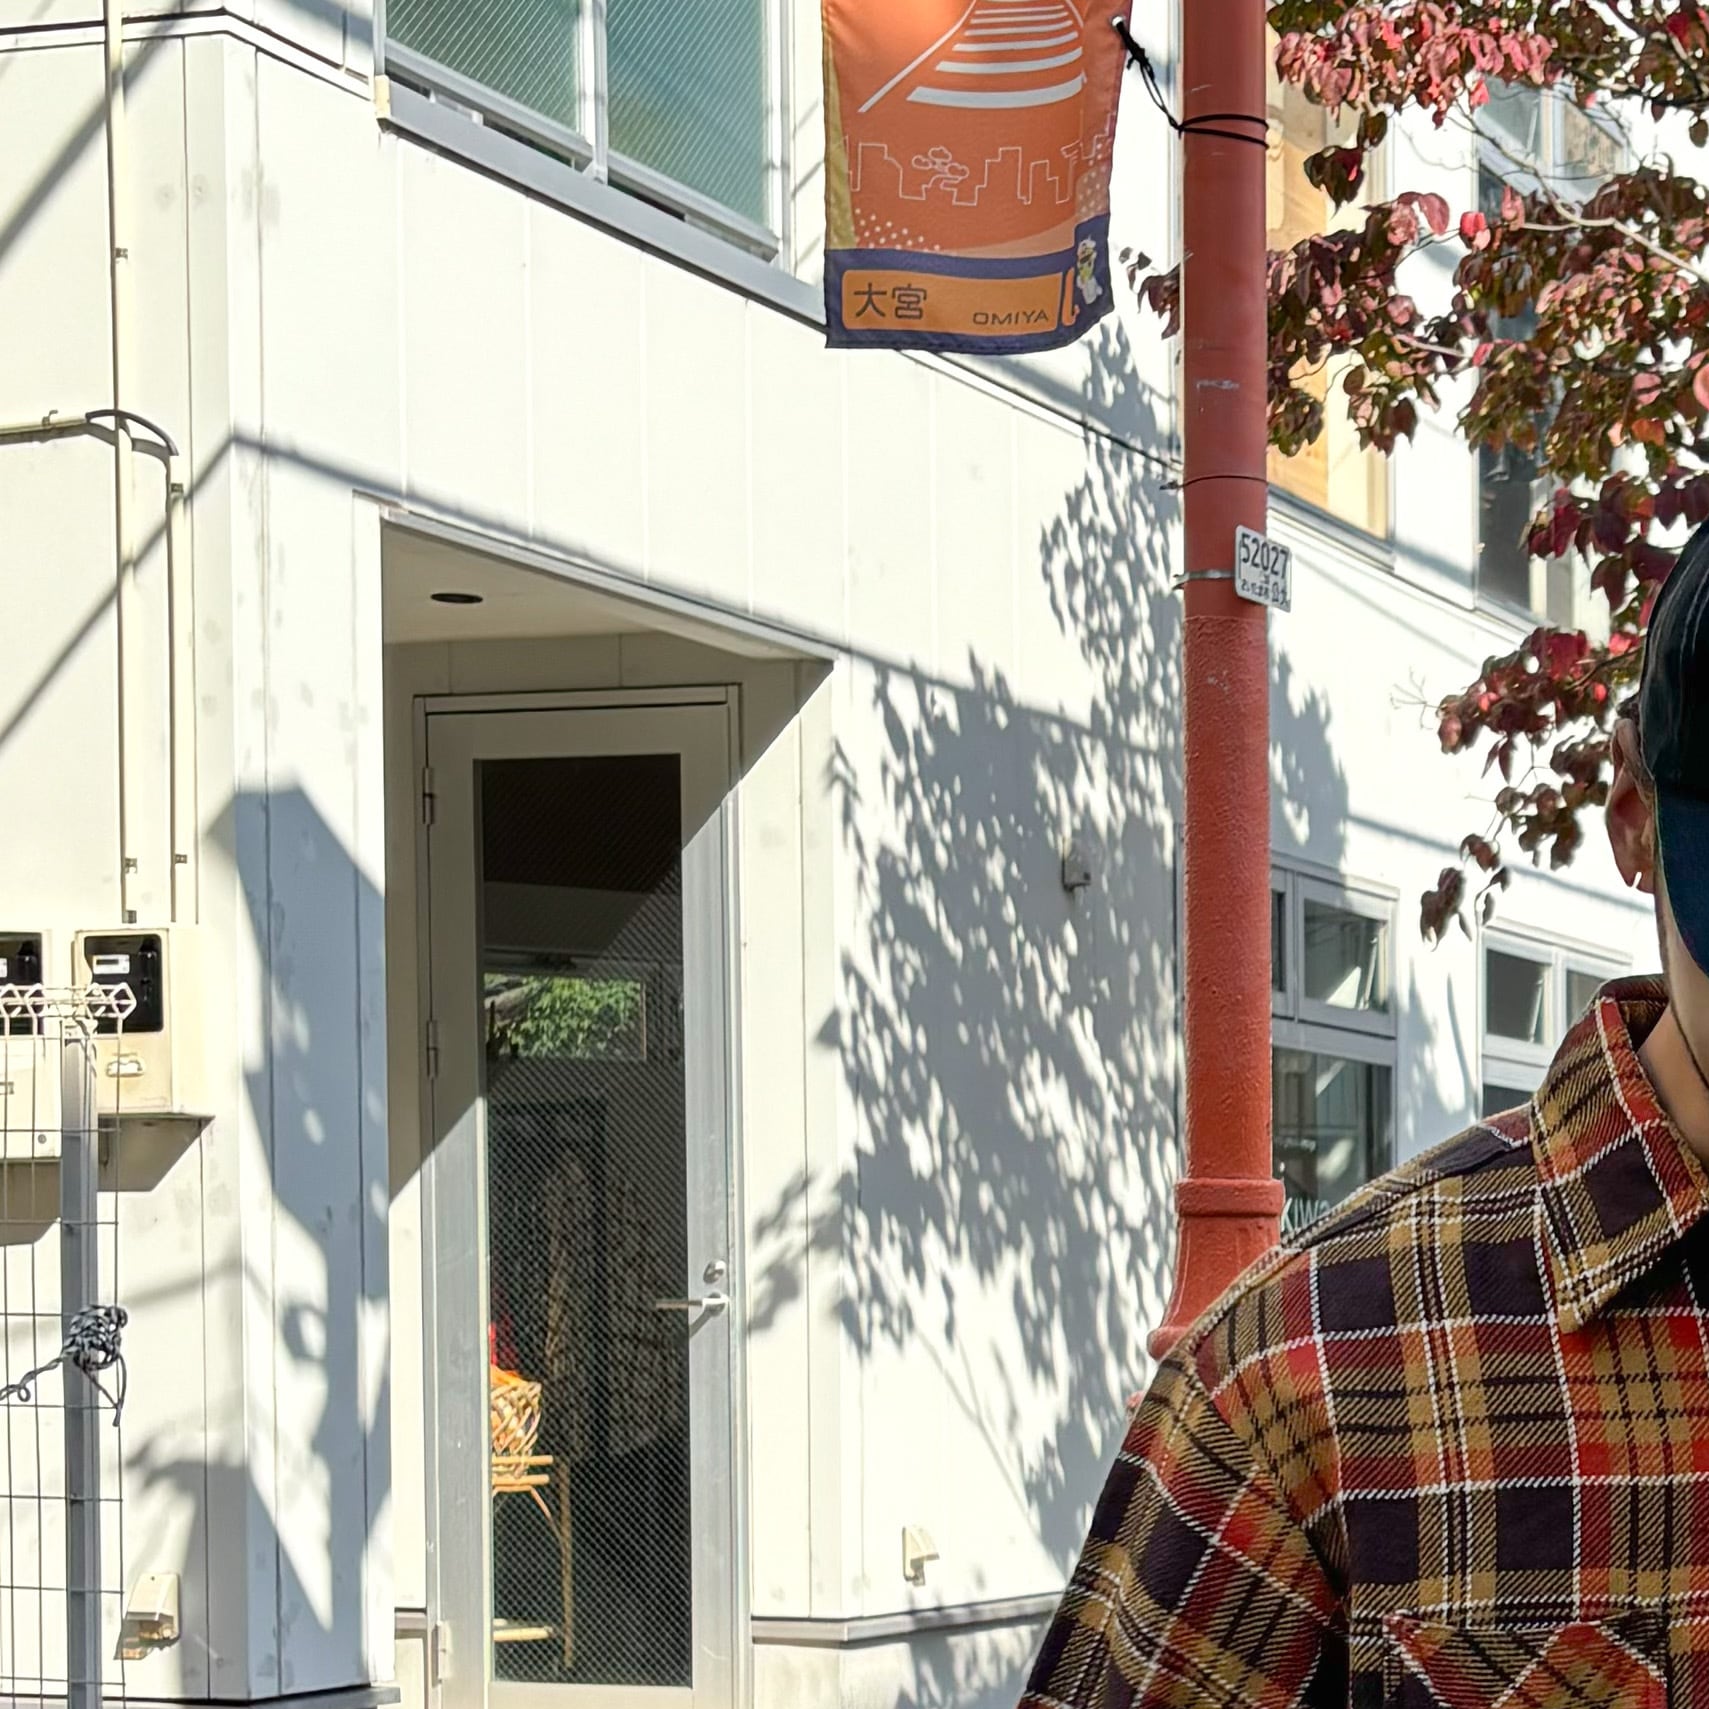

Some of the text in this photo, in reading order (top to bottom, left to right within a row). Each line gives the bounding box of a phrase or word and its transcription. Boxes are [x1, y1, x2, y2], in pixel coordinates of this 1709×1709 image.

[853, 283, 1049, 326] 大宮 OMIYA
[1241, 532, 1289, 579] 52027
